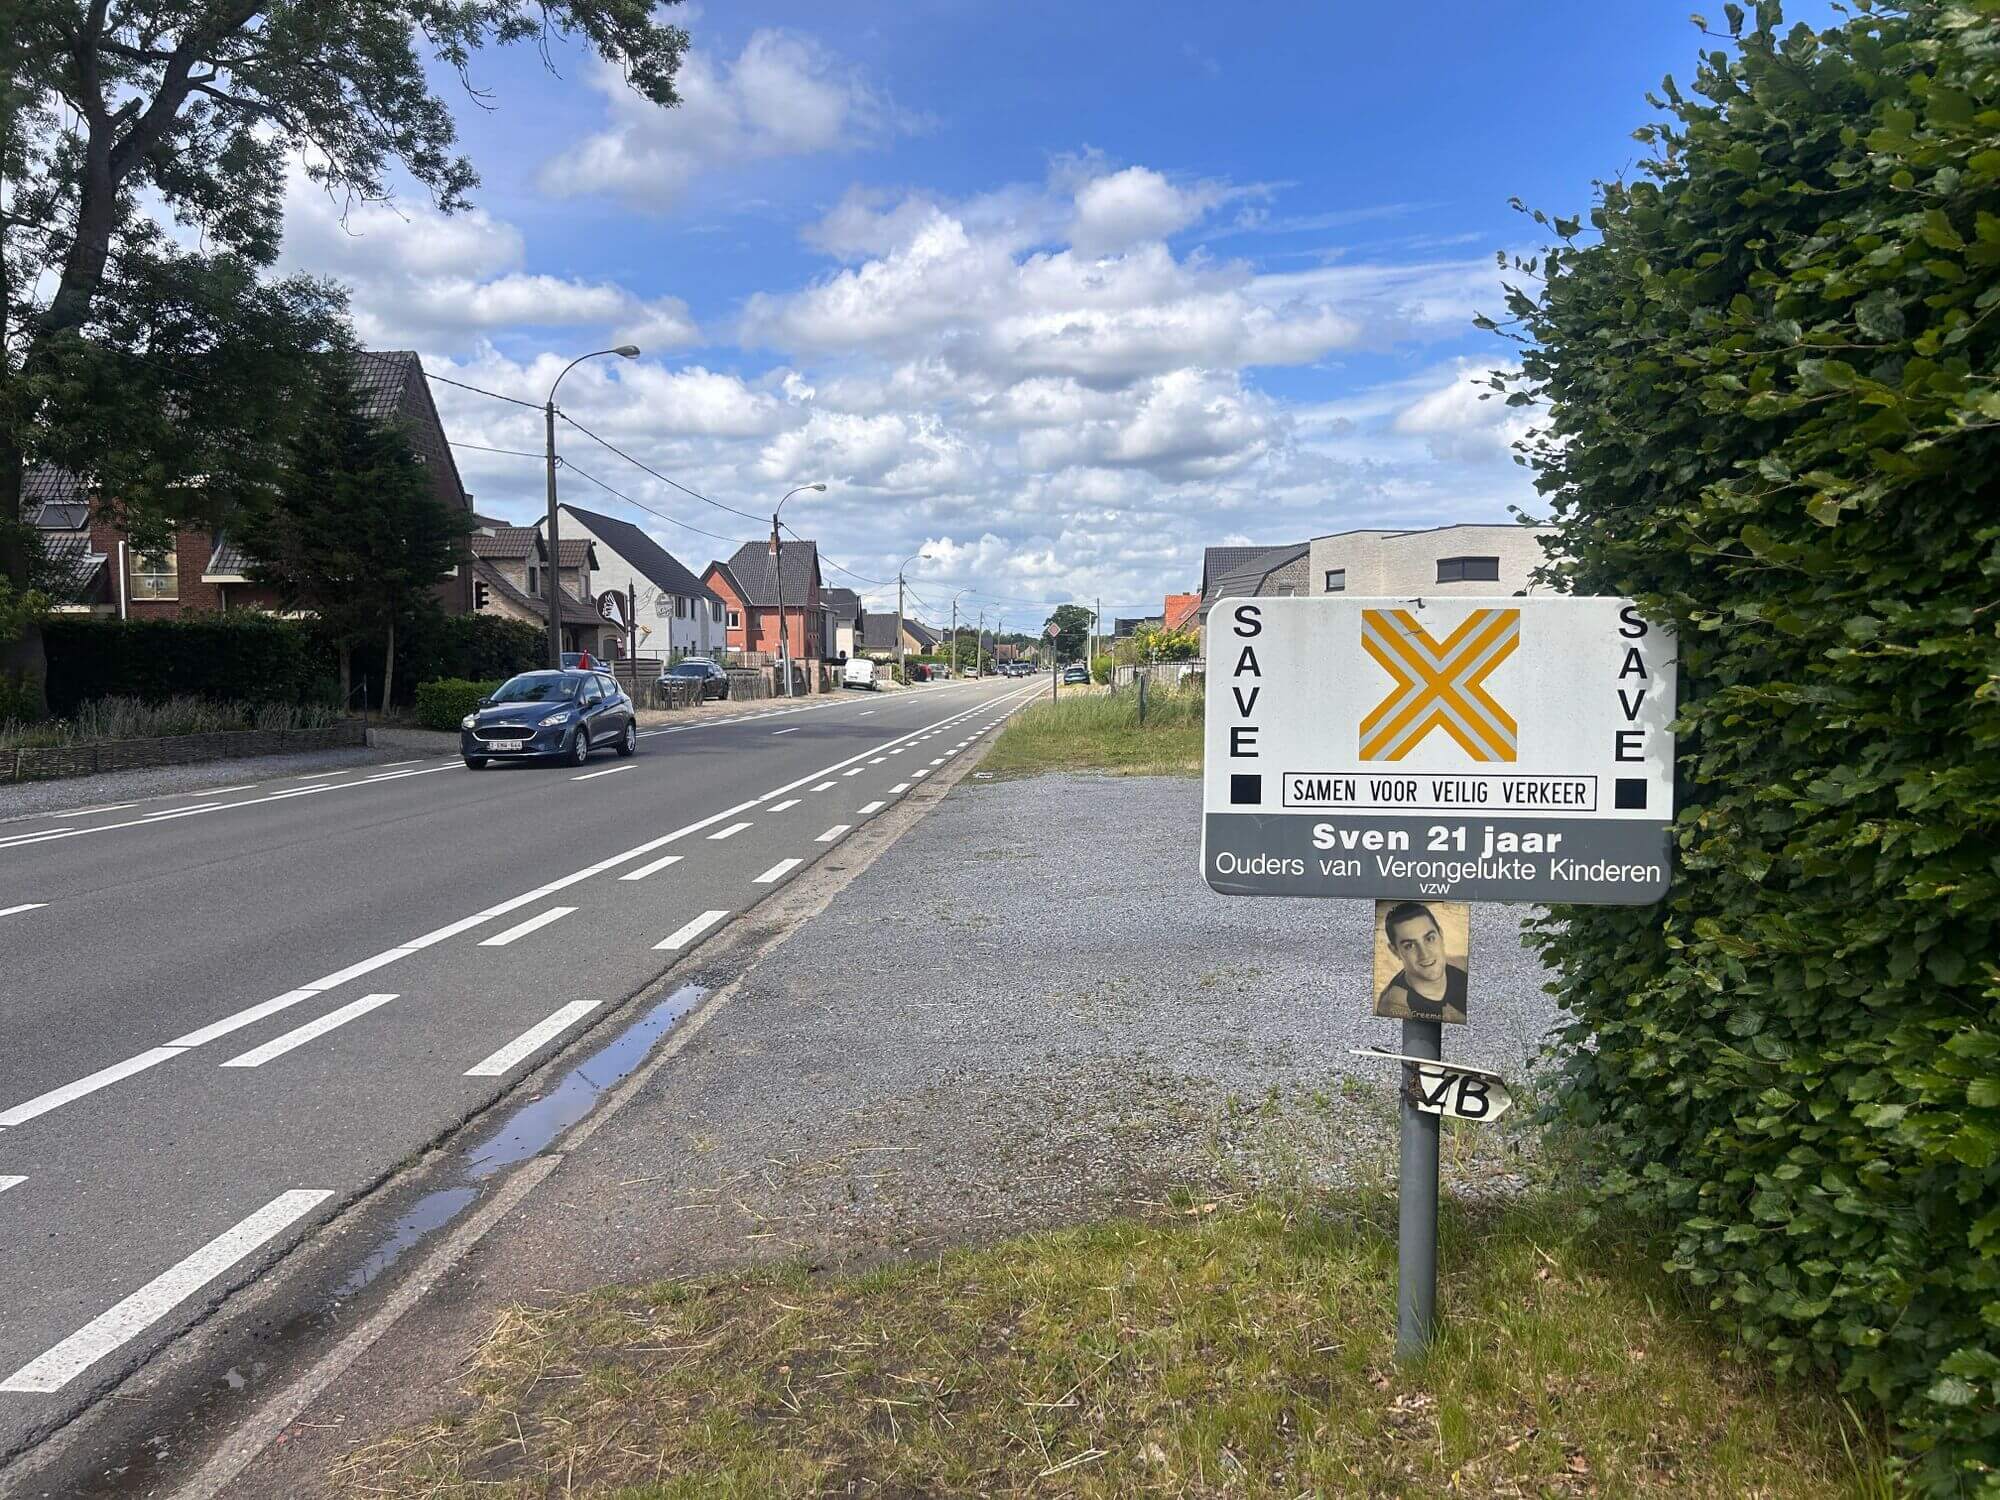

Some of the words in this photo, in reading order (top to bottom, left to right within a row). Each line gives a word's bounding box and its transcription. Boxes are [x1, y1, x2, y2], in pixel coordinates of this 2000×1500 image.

[1230, 605, 1262, 758] SAVE
[1614, 606, 1649, 762] SAVE
[1293, 779, 1356, 801] SAMEN
[1370, 780, 1418, 802] VOOR
[1432, 781, 1488, 803] VEILIG
[1502, 781, 1586, 804] VERKEER
[1312, 823, 1410, 851] Sven
[1427, 825, 1467, 852] 21
[1481, 825, 1562, 859] jaar
[1215, 852, 1305, 876] Ouders
[1319, 858, 1361, 877] van
[1375, 855, 1536, 883] Verongelukte
[1549, 858, 1661, 883] Kinderen
